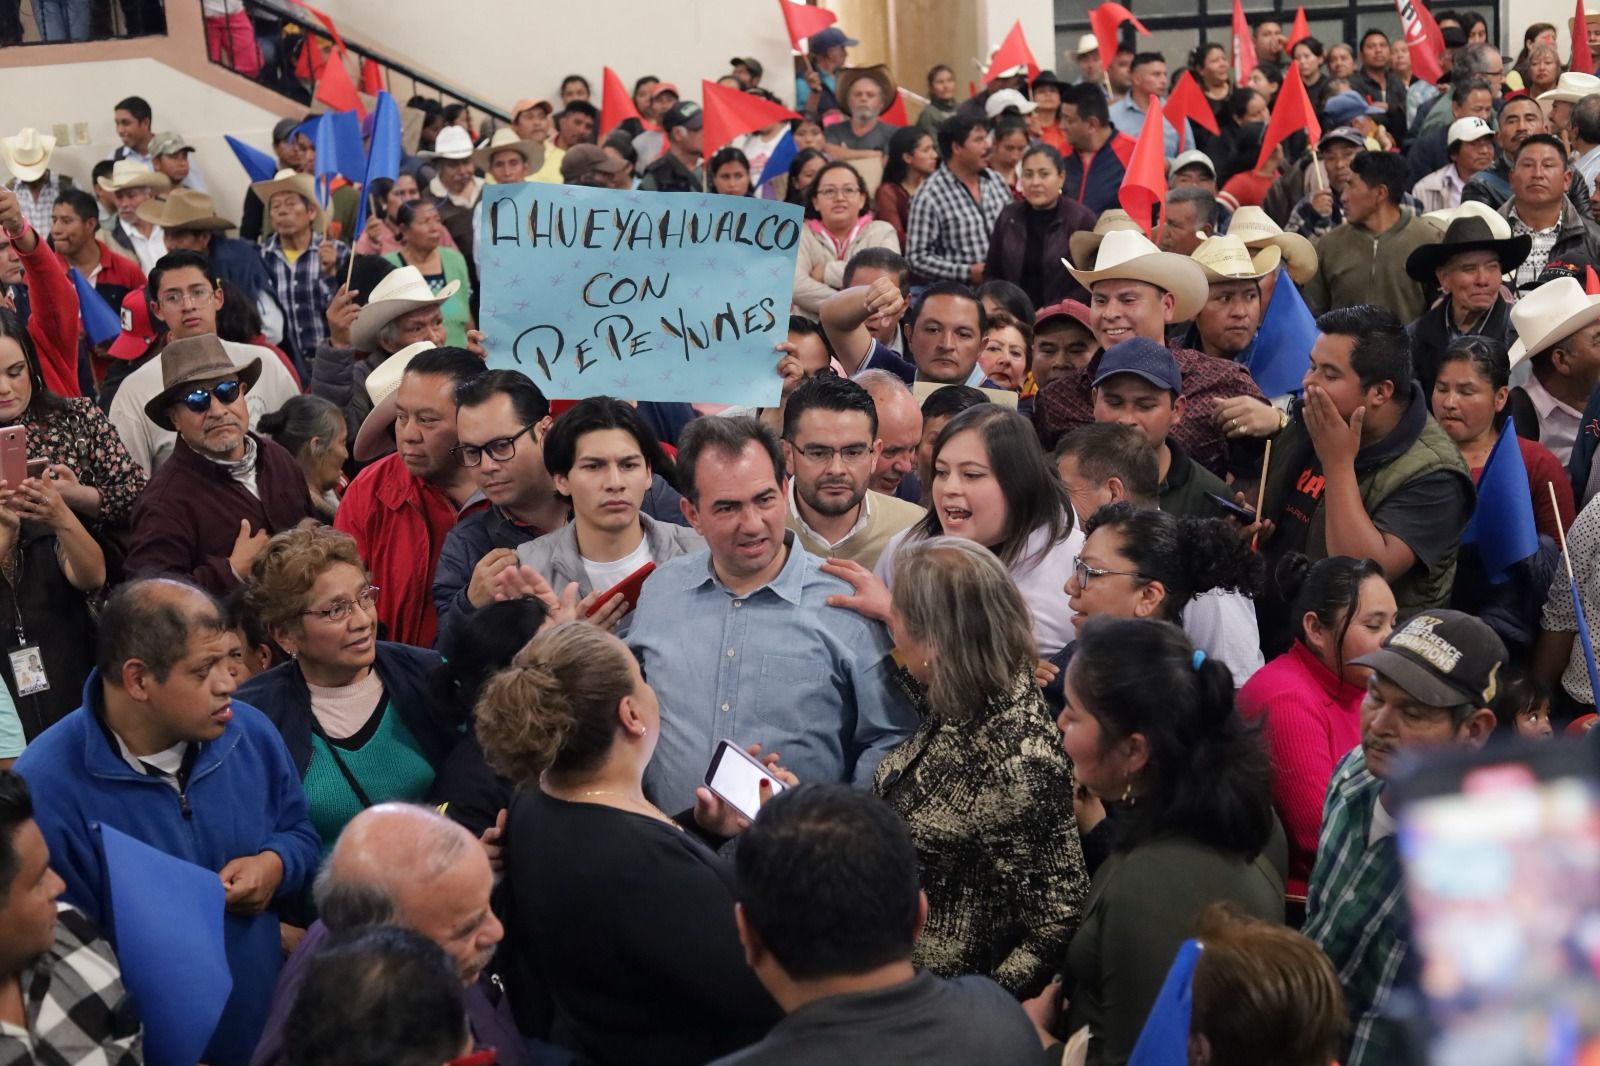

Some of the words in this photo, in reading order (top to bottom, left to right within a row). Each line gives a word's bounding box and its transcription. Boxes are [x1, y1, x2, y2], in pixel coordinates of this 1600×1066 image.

[490, 197, 800, 251] AHUEYAHUALCO
[582, 272, 670, 308] CON
[512, 314, 653, 382] PEPE
[660, 297, 775, 362] YUNES
